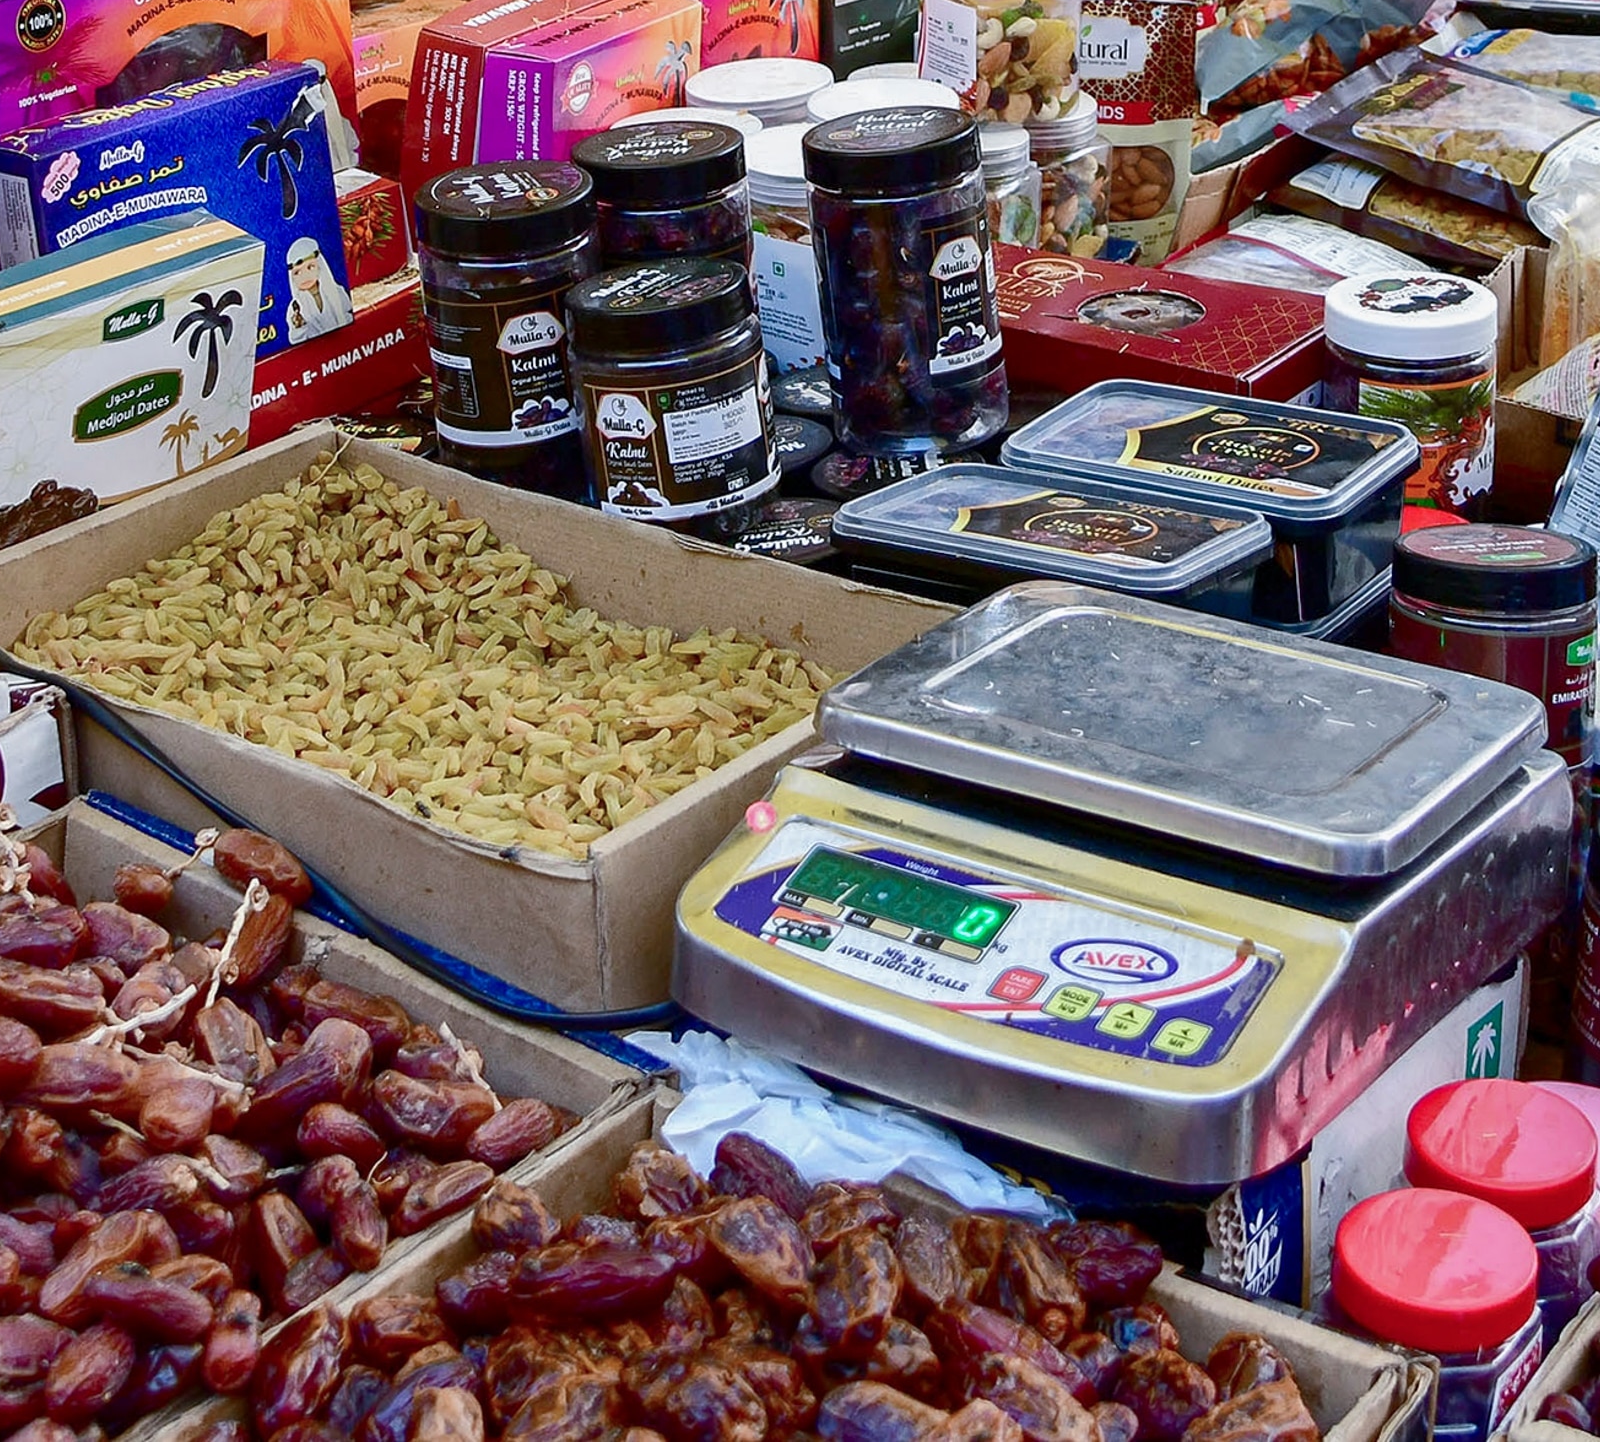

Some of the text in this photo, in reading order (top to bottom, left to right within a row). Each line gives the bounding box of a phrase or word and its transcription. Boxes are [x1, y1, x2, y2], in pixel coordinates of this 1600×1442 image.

[29, 13, 53, 31] 100%
[708, 15, 780, 51] MADINA-E-MUNAWARA
[432, 50, 441, 65] Unit
[1080, 39, 1128, 59] tural
[429, 66, 439, 82] Sale
[19, 85, 77, 108] 100% Vegetarian
[426, 84, 436, 102] Price
[443, 54, 458, 121] NET WEIGHT 500
[565, 80, 596, 100] QUALITY
[450, 57, 469, 161] Keep refrigerated always
[516, 71, 525, 142] GROSS WEIGHT
[531, 73, 541, 150] Keep refrigerated
[99, 141, 145, 170] Mulla-G
[50, 174, 70, 198] 500
[70, 157, 184, 209] تمر صفاوي
[57, 188, 207, 248] MADINA-E-MUNAWARA
[939, 255, 978, 277] Mulla-G
[943, 280, 979, 300] Kalmi
[109, 303, 158, 333] Mulla-G
[508, 326, 556, 346] Mulla-G
[321, 328, 405, 378] MUNAWARA
[512, 353, 557, 373] Kalmi
[105, 379, 155, 409] تمر مجول
[87, 395, 170, 435] Medjoul Dates
[602, 417, 645, 435] Mulla-G
[606, 442, 648, 458] Kalmi
[1161, 466, 1275, 493] Safawi Dates
[904, 860, 939, 877] Weight
[956, 907, 999, 939] 0
[882, 946, 927, 969] Mfg. By
[991, 941, 1007, 953] kg
[837, 945, 969, 992] AVEX DIGITAL SCALE
[1072, 951, 1159, 971] AVEX
[1009, 973, 1034, 986] TARE
[1003, 987, 1023, 997] ENT
[1062, 989, 1090, 1004] MODE
[1168, 1038, 1184, 1049] MR
